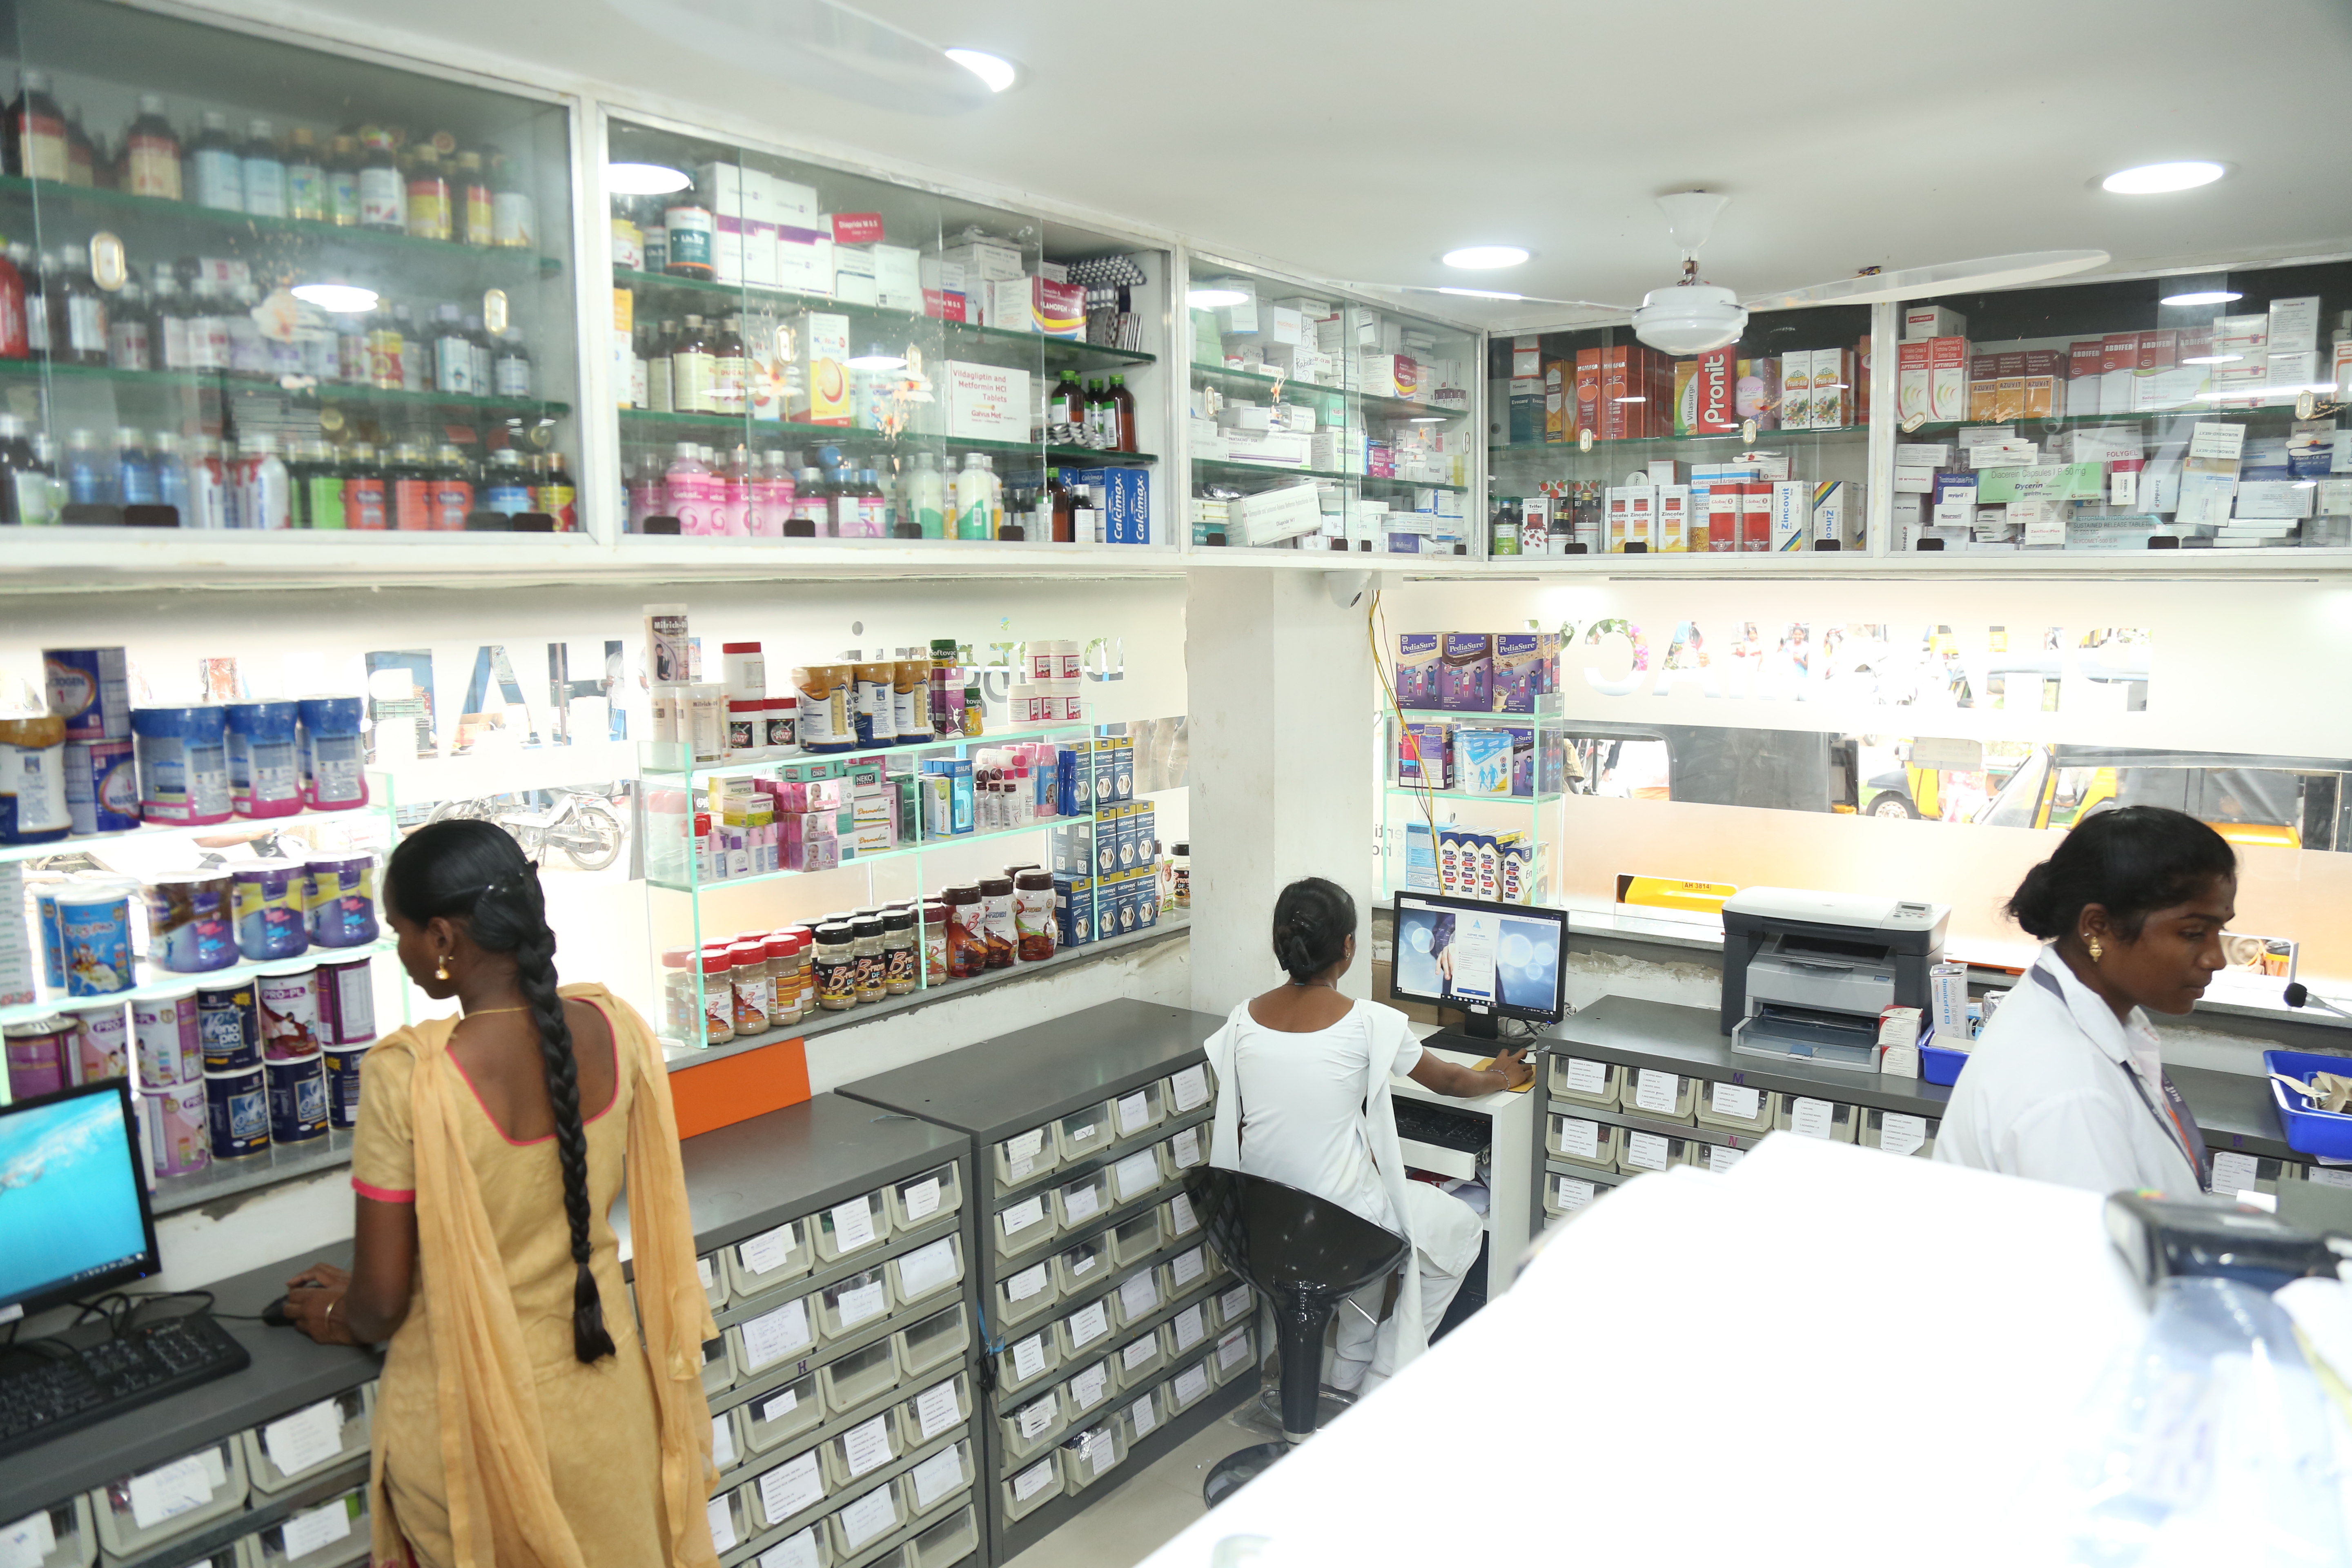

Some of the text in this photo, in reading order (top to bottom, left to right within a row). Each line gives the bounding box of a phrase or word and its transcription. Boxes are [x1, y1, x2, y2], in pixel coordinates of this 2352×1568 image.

[2142, 341, 2171, 349] ABDIFER
[2180, 338, 2204, 346] ABDIFE
[953, 370, 992, 381] Vildagliptin
[958, 381, 993, 391] Metformin
[1704, 354, 1724, 423] Pronit
[1787, 379, 1807, 388] Fruit-Aid
[983, 394, 1007, 402] Tablets
[1687, 384, 1695, 421] Vitasurge
[2022, 470, 2051, 479] Capsules
[1402, 642, 1435, 653] PediaSure
[1449, 642, 1483, 653] PediaSure
[1499, 642, 1535, 653] PediaSure
[856, 774, 873, 784] NEKO
[1118, 882, 1136, 890] Lactaways
[1137, 878, 1154, 886] Lactaways
[1098, 887, 1116, 895] Lactaways
[1073, 893, 1091, 901] Lactaways
[1733, 1072, 1744, 1085] M
[797, 1361, 808, 1374] H
